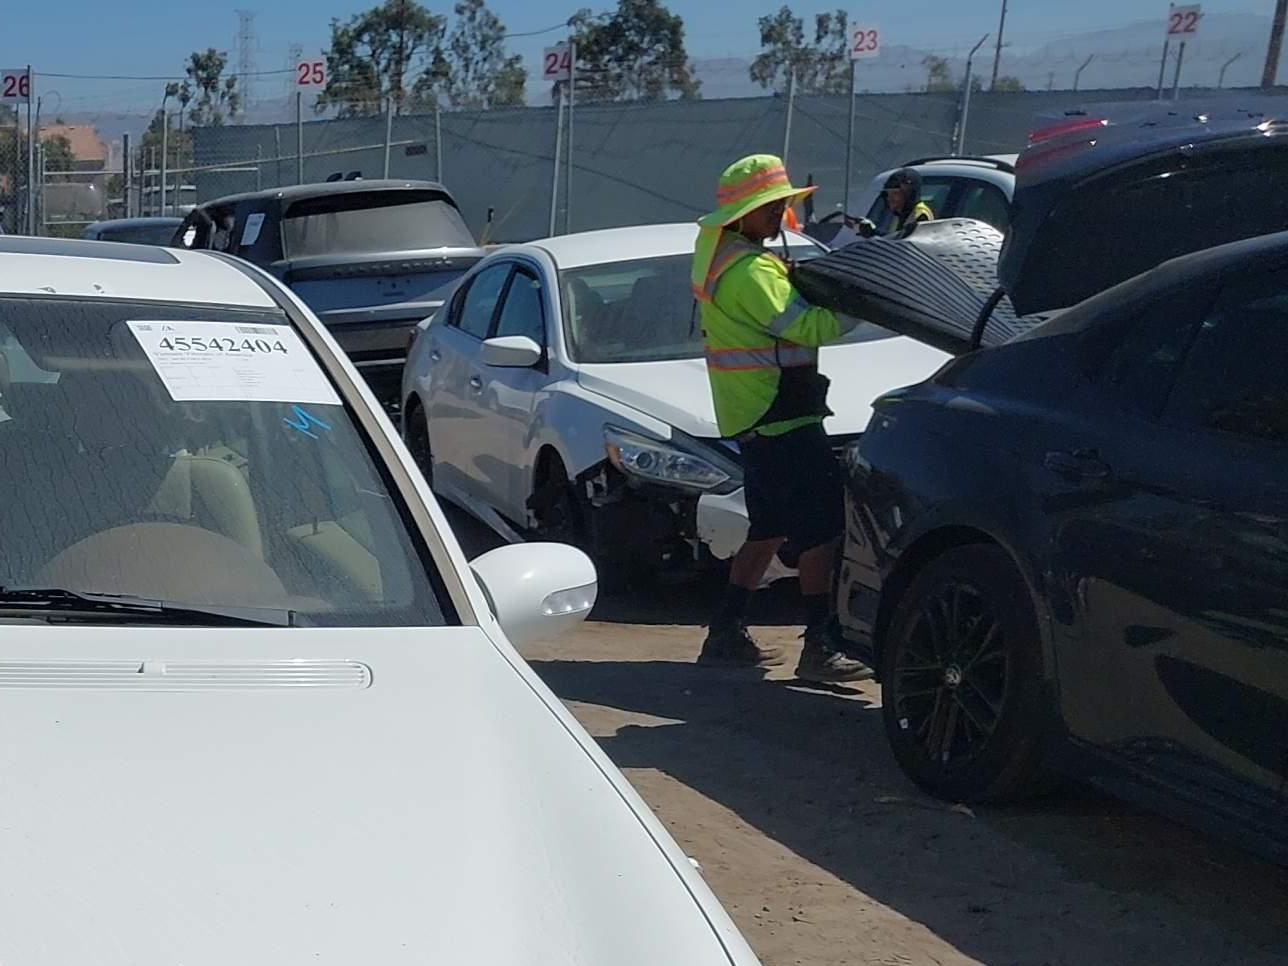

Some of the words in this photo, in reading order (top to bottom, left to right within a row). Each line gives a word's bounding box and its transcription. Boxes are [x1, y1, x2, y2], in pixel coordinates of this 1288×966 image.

[1168, 11, 1197, 34] 22
[854, 30, 878, 52] 23
[298, 62, 324, 84] 25
[545, 52, 571, 74] 24
[3, 75, 30, 97] 26
[159, 336, 289, 355] 45542404
